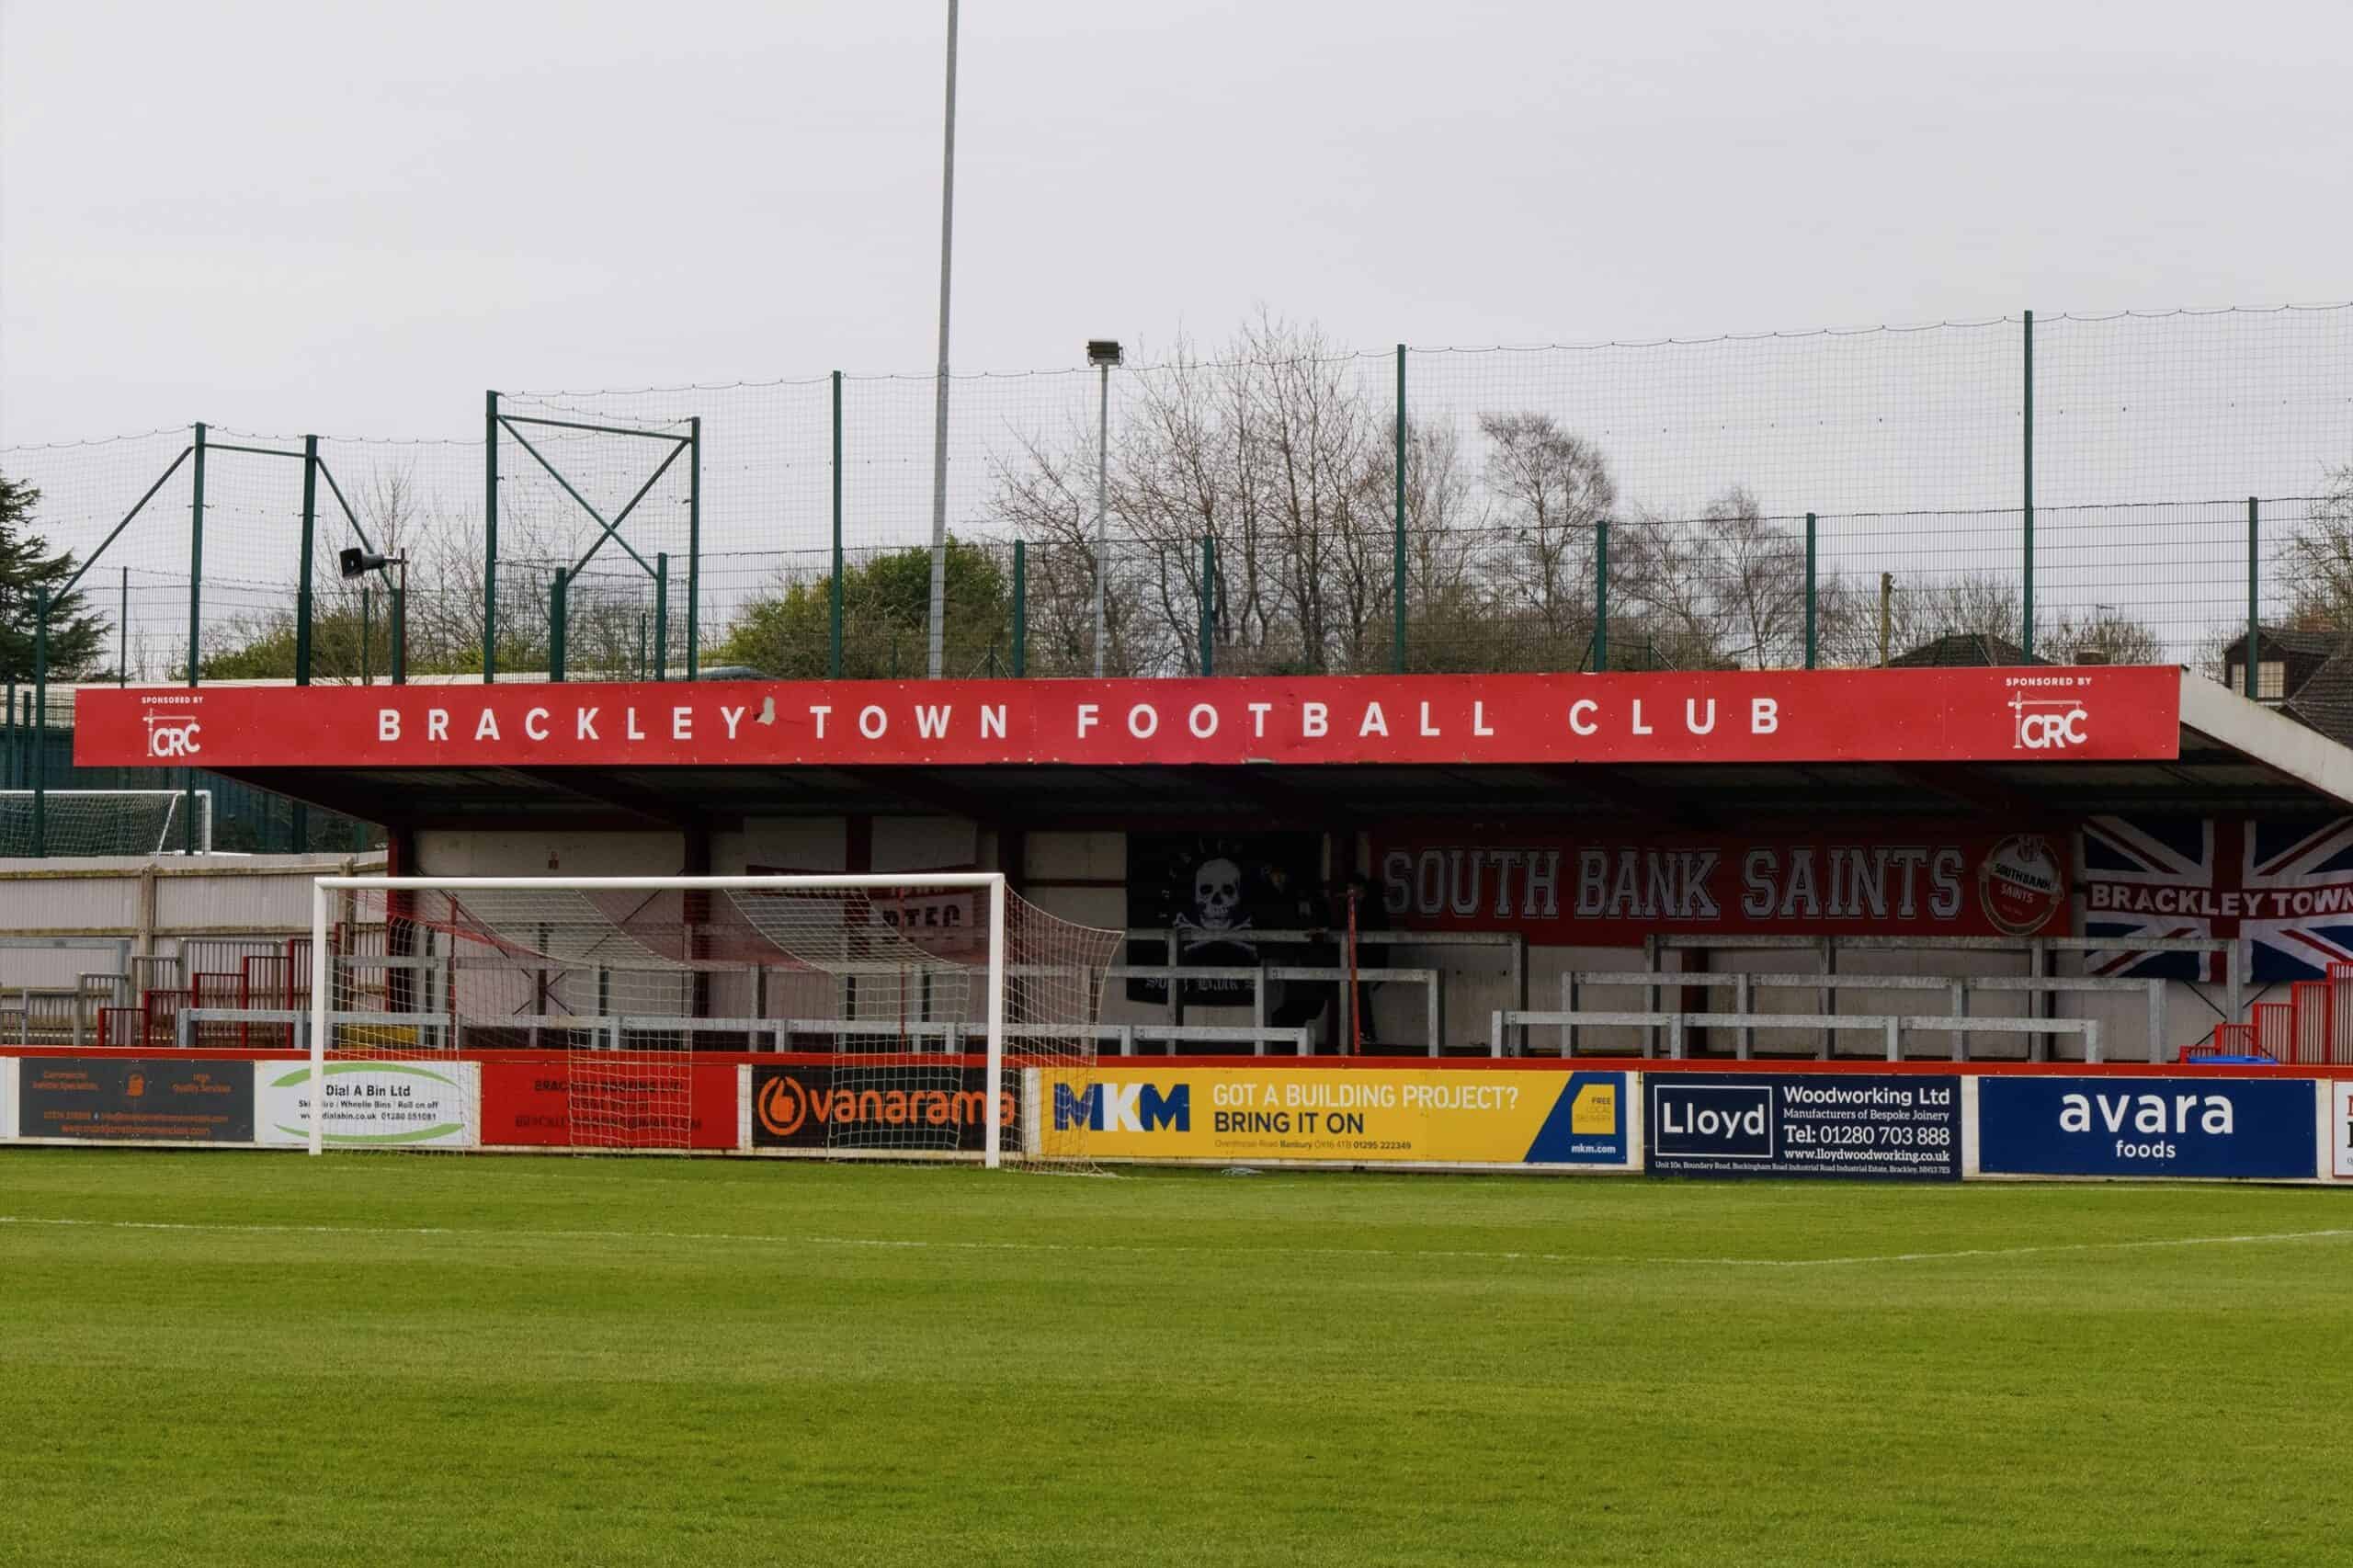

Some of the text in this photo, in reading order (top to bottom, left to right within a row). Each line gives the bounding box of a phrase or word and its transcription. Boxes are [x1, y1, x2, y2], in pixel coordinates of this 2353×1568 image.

[2006, 676, 2092, 687] SPONSORED BY
[142, 697, 204, 705] SPONSORED BY
[378, 697, 1779, 742] BRACKLEY TOWN FOOTBALL CLUB
[2021, 710, 2088, 749] CRC
[153, 723, 200, 757] CRC
[1381, 845, 1964, 919] SOUTH BANK SAINTS
[2000, 883, 2033, 904] SAINTS
[2090, 883, 2266, 916] BRACKLEY
[325, 1085, 411, 1096] Dial A Bin Ltd
[1213, 1084, 1519, 1110] GOT A BUILDING PROJECT?
[1783, 1085, 1950, 1107] Woodworking Ltd
[375, 1100, 392, 1108] Bins
[810, 1089, 1015, 1126] vanarama
[1054, 1083, 1190, 1131] MKM
[1783, 1108, 1949, 1122] Manufacturers of Bespoke Joinery
[2059, 1092, 2234, 1135] avara
[1214, 1111, 1364, 1134] BRING IT ON
[1664, 1102, 1765, 1139] Lloyd
[1280, 1140, 1312, 1151] Banbury
[1353, 1141, 1378, 1150] 01295
[1783, 1124, 1950, 1146] Tel: 01280 703 888
[1572, 1142, 1616, 1154] mkm.com
[1785, 1148, 1949, 1163] www.lloydwoodworking.co.uk
[2116, 1140, 2177, 1158] foods
[1655, 1161, 1669, 1169] Unit
[1683, 1162, 1713, 1171] Boundary
